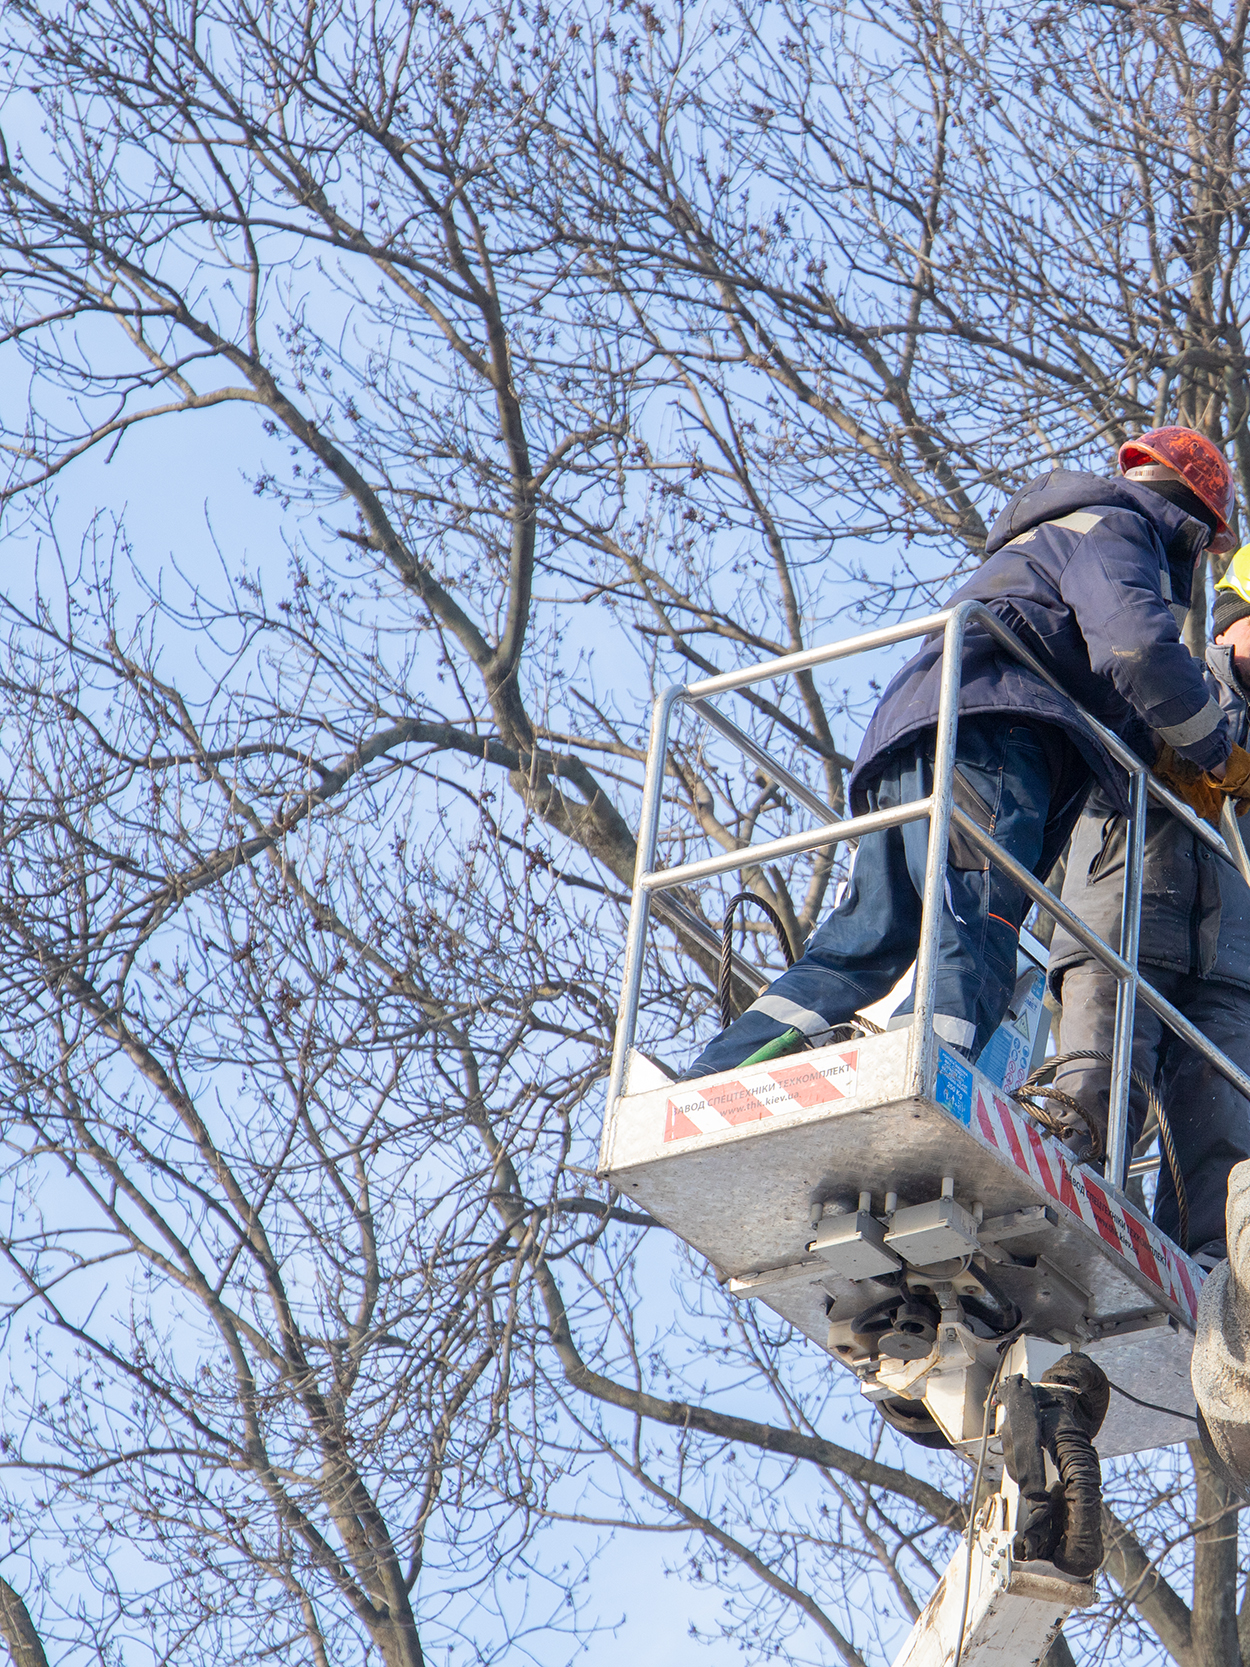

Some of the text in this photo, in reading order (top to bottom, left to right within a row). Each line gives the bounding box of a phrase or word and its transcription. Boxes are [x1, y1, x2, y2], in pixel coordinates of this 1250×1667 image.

[673, 1063, 851, 1115] ЗАВОД СПЕЦТЕХНІКИ ТЕХКОМПЛЕКТ
[719, 1091, 800, 1117] www.thk.kiev.ua
